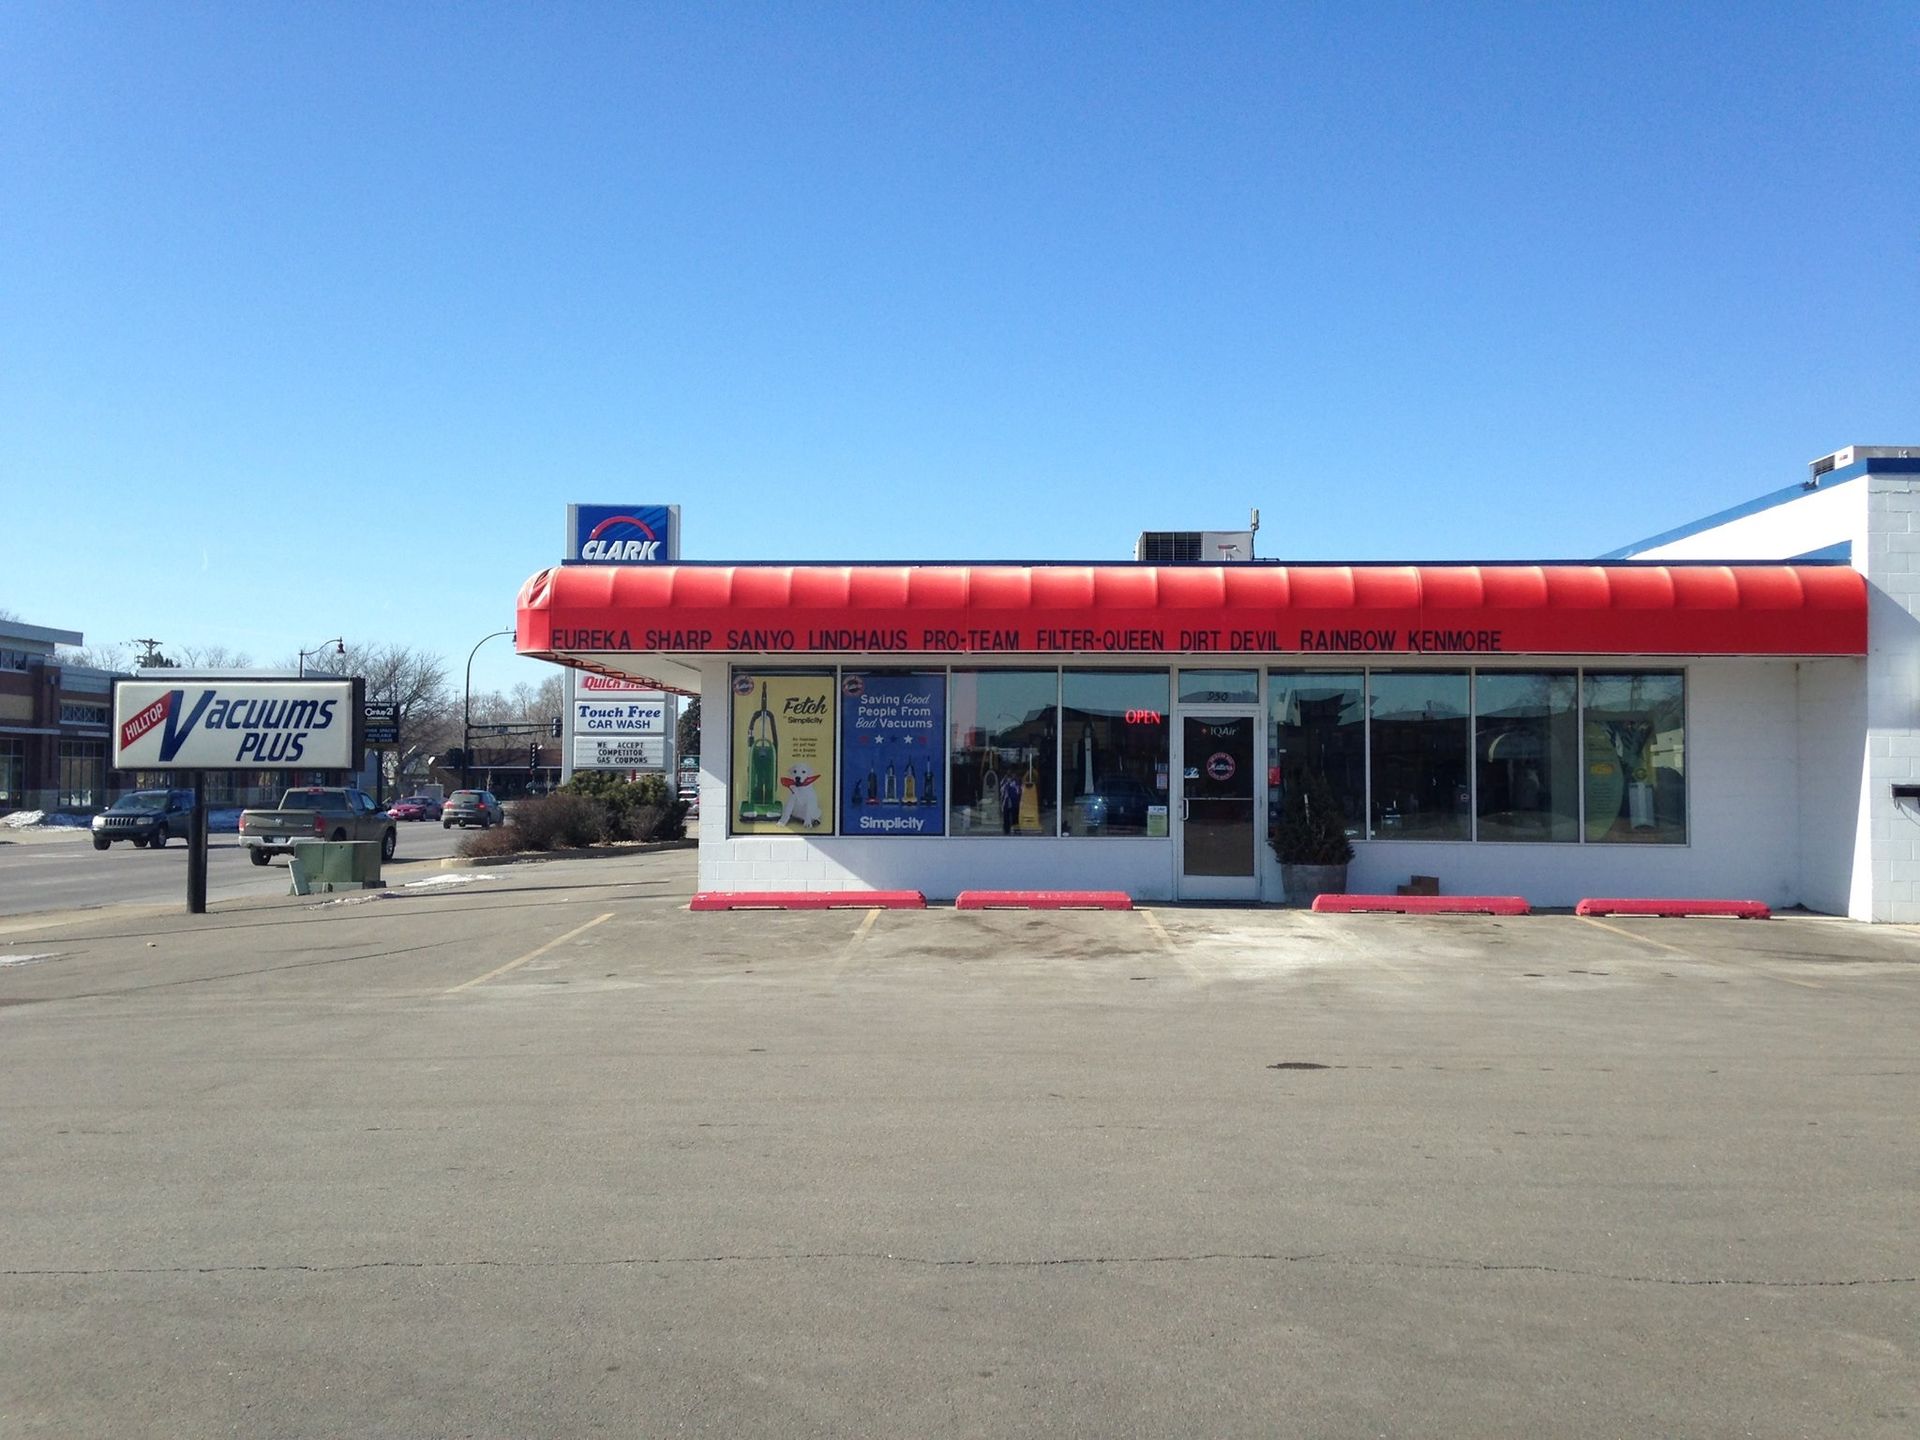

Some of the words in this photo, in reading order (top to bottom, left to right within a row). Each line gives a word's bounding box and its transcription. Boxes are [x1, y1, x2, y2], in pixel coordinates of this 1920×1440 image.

[581, 540, 661, 560] CLARK
[552, 630, 631, 650] EUREKA
[646, 630, 712, 650] SHARP
[727, 630, 794, 650] SANYO
[809, 630, 907, 650] LINDHAUS
[923, 630, 1019, 650] PRO-TEAM
[1037, 630, 1164, 650] FILTER-QUEEN
[1180, 630, 1221, 650] DIRT
[1230, 630, 1281, 650] DEVIL
[1301, 630, 1396, 650] RAINBOW
[1408, 630, 1501, 651] KENMORE
[783, 694, 828, 715] Fetch
[860, 694, 900, 706] Saving
[903, 693, 931, 704] Good
[579, 705, 623, 718] Touch
[627, 705, 661, 718] Free
[858, 706, 897, 717] People
[901, 706, 931, 716] From
[1125, 709, 1161, 724] OPEN
[125, 702, 164, 740] HILLTOP
[587, 720, 613, 729] CAR
[616, 720, 651, 729] WASH
[788, 716, 823, 725] Simplicity
[855, 717, 878, 728] Bad
[880, 718, 933, 728] Vacuums
[1210, 727, 1237, 737] IQAir
[235, 732, 308, 762] PLUS
[860, 816, 924, 831] Simplicity
